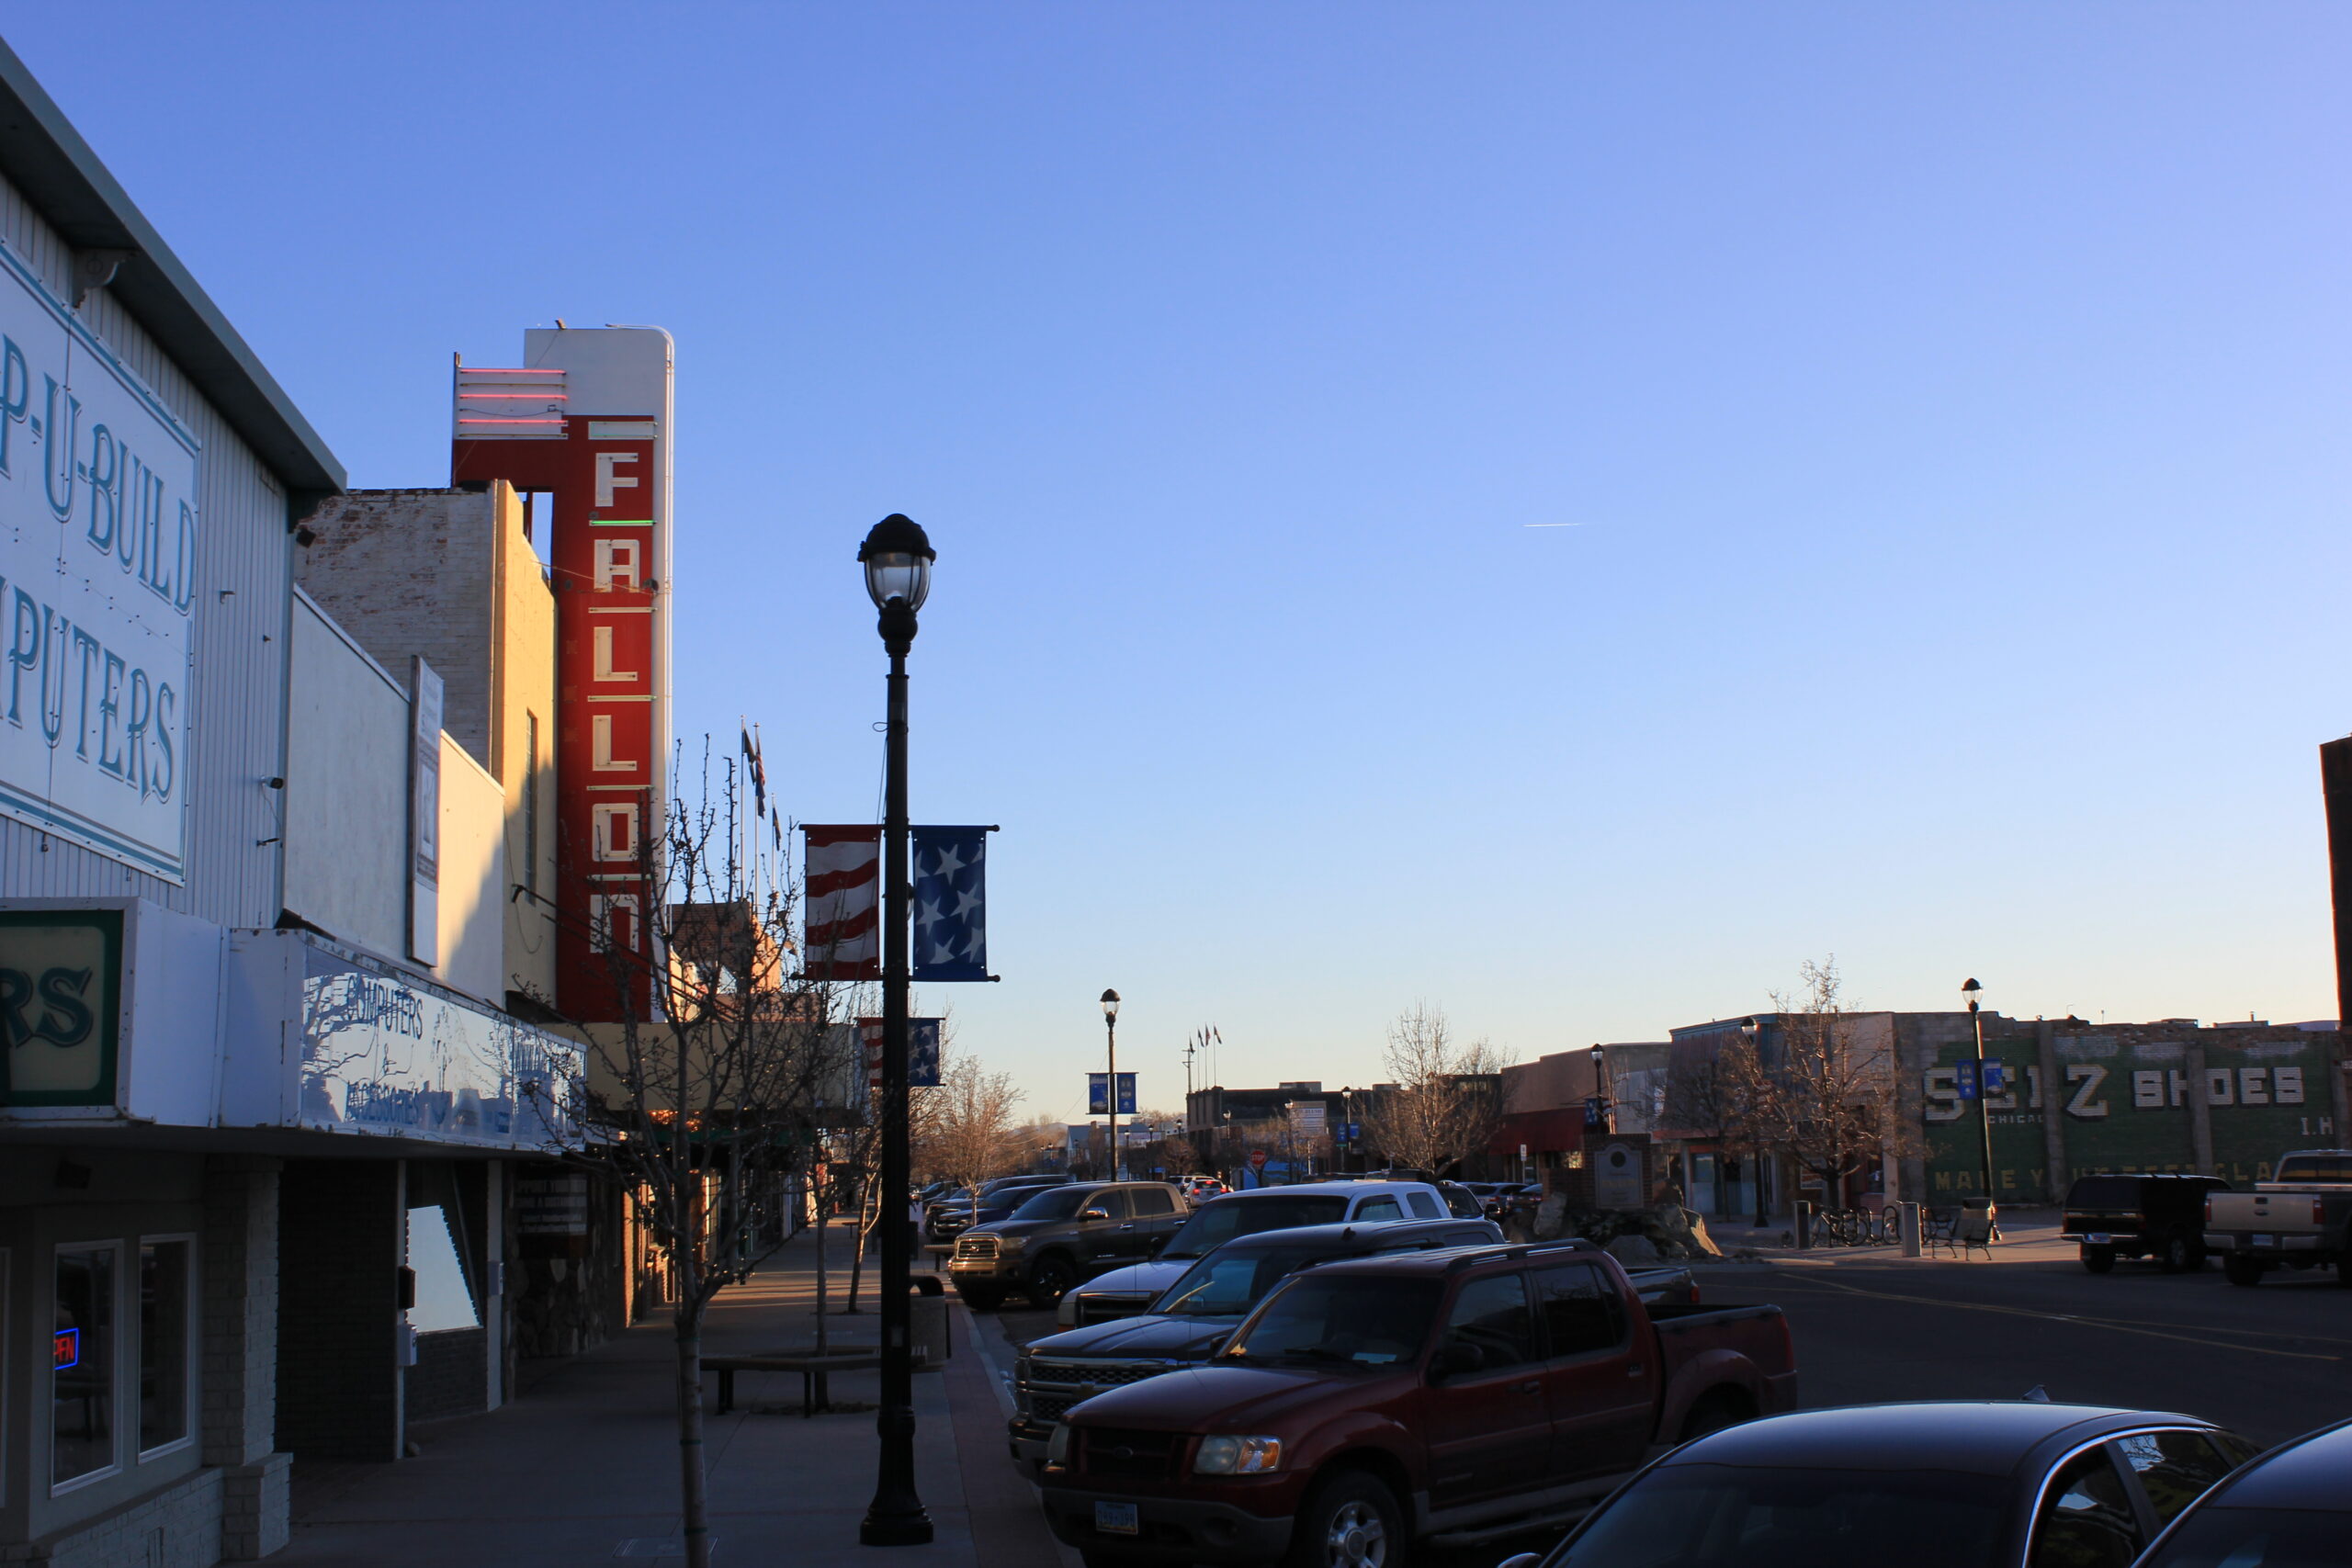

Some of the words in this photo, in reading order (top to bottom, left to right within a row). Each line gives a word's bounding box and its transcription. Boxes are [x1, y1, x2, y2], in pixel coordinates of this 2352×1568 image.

[0, 575, 175, 805] PUTERS
[589, 452, 640, 954] FALLON
[346, 974, 424, 1041] COMPUTERS
[2132, 1066, 2305, 1108] SHOES
